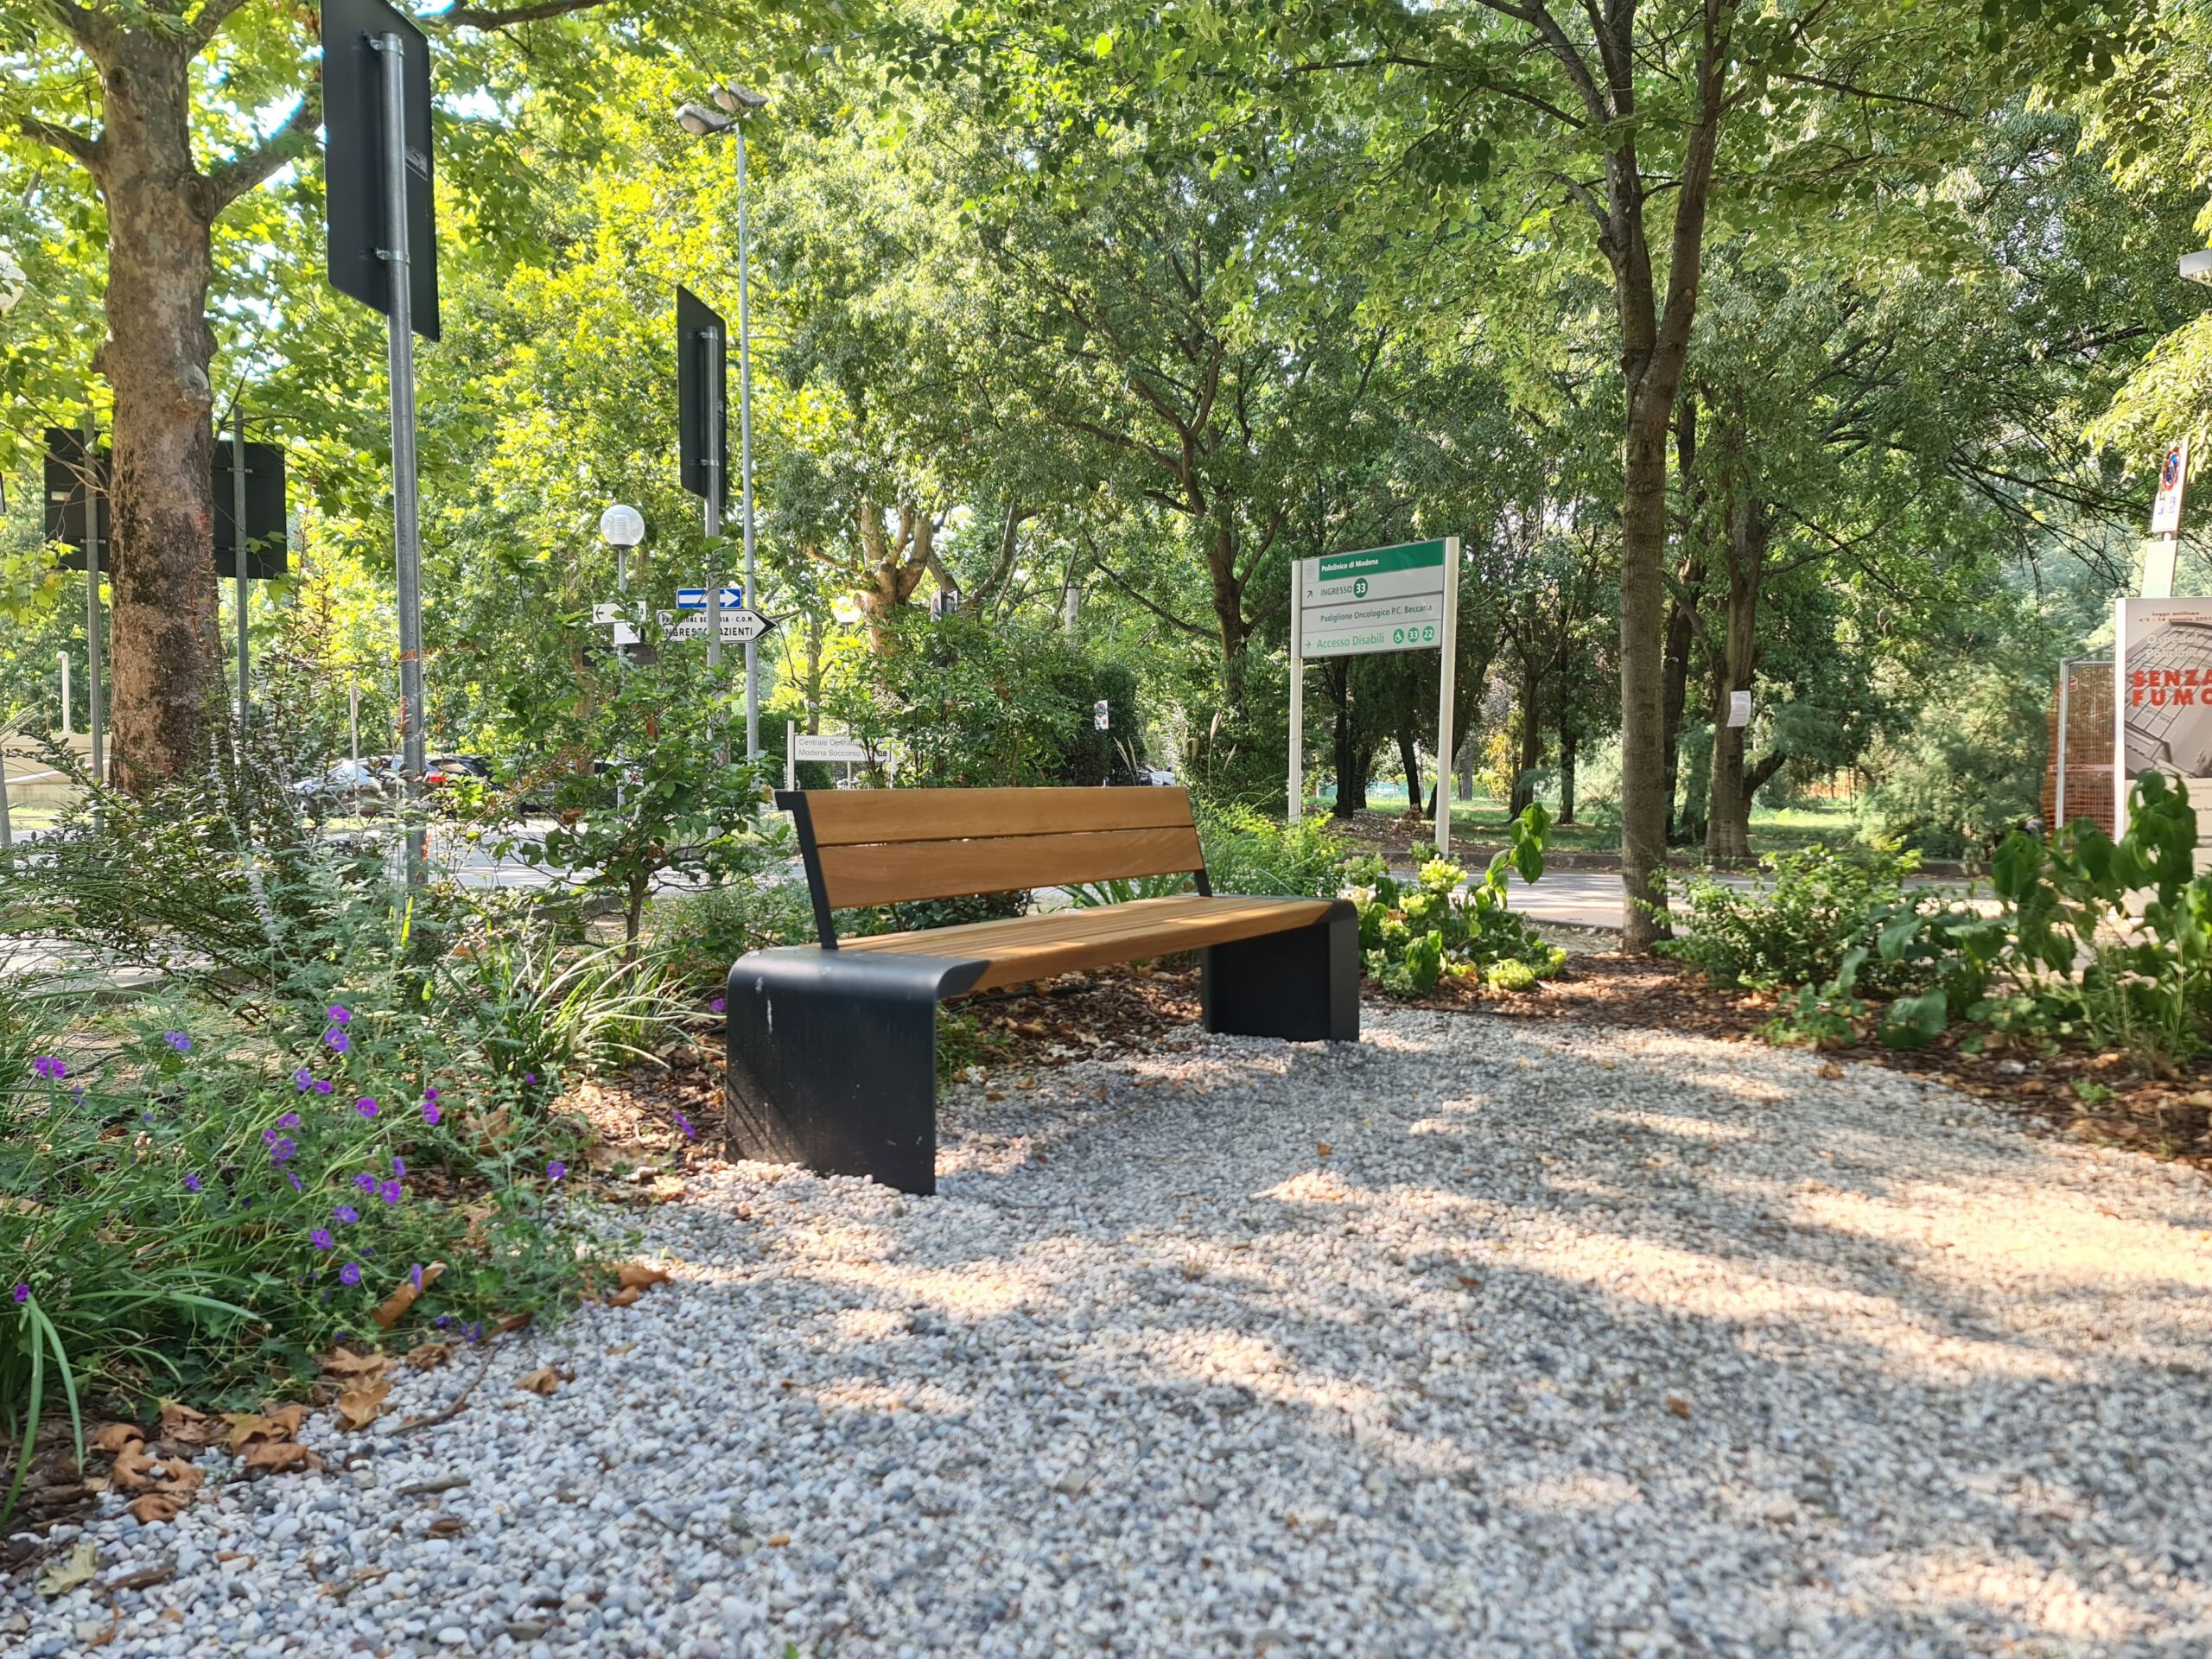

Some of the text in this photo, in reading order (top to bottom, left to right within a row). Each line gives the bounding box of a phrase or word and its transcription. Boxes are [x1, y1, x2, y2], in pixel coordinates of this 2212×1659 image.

[1321, 563, 1348, 572] Policlinico
[1356, 558, 1378, 567] Modena
[1321, 583, 1365, 596] INGRESSO 33
[1320, 613, 1352, 623] Padiglione
[1354, 609, 1389, 619] Oncologico
[1404, 602, 1432, 613] Beccaria
[720, 627, 753, 636] AZIENTI
[2147, 632, 2206, 644] Ospedale
[1317, 629, 1433, 649] Accesso Disabili 33 22
